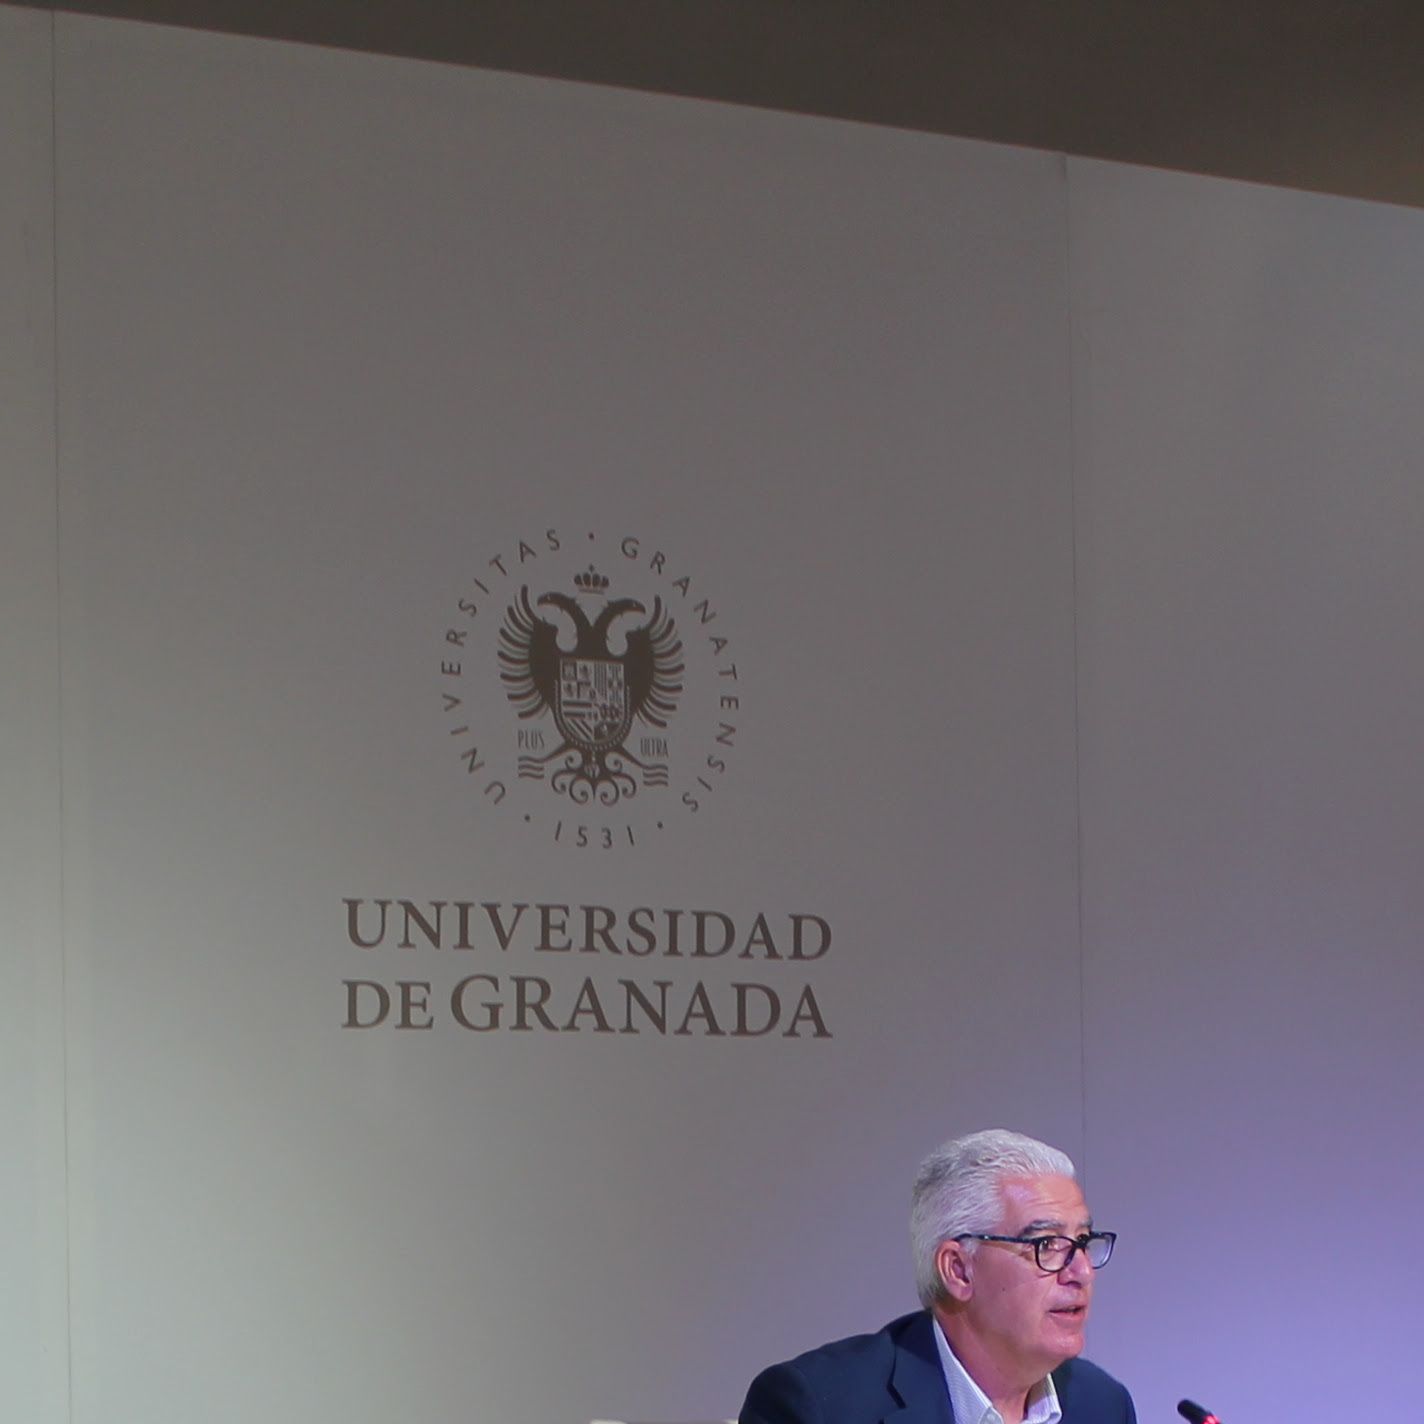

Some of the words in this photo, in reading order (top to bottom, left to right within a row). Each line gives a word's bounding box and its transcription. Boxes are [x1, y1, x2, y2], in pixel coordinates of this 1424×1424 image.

[441, 527, 562, 806] UNIVERSITAS
[619, 536, 740, 814] GRANATENSIS
[517, 729, 546, 750] PLUS
[639, 737, 670, 759] ULTRA
[554, 819, 637, 850] 1531
[342, 897, 834, 961] UNIVERSIDAD
[342, 979, 435, 1031] DE
[449, 973, 834, 1040] GRANADA
